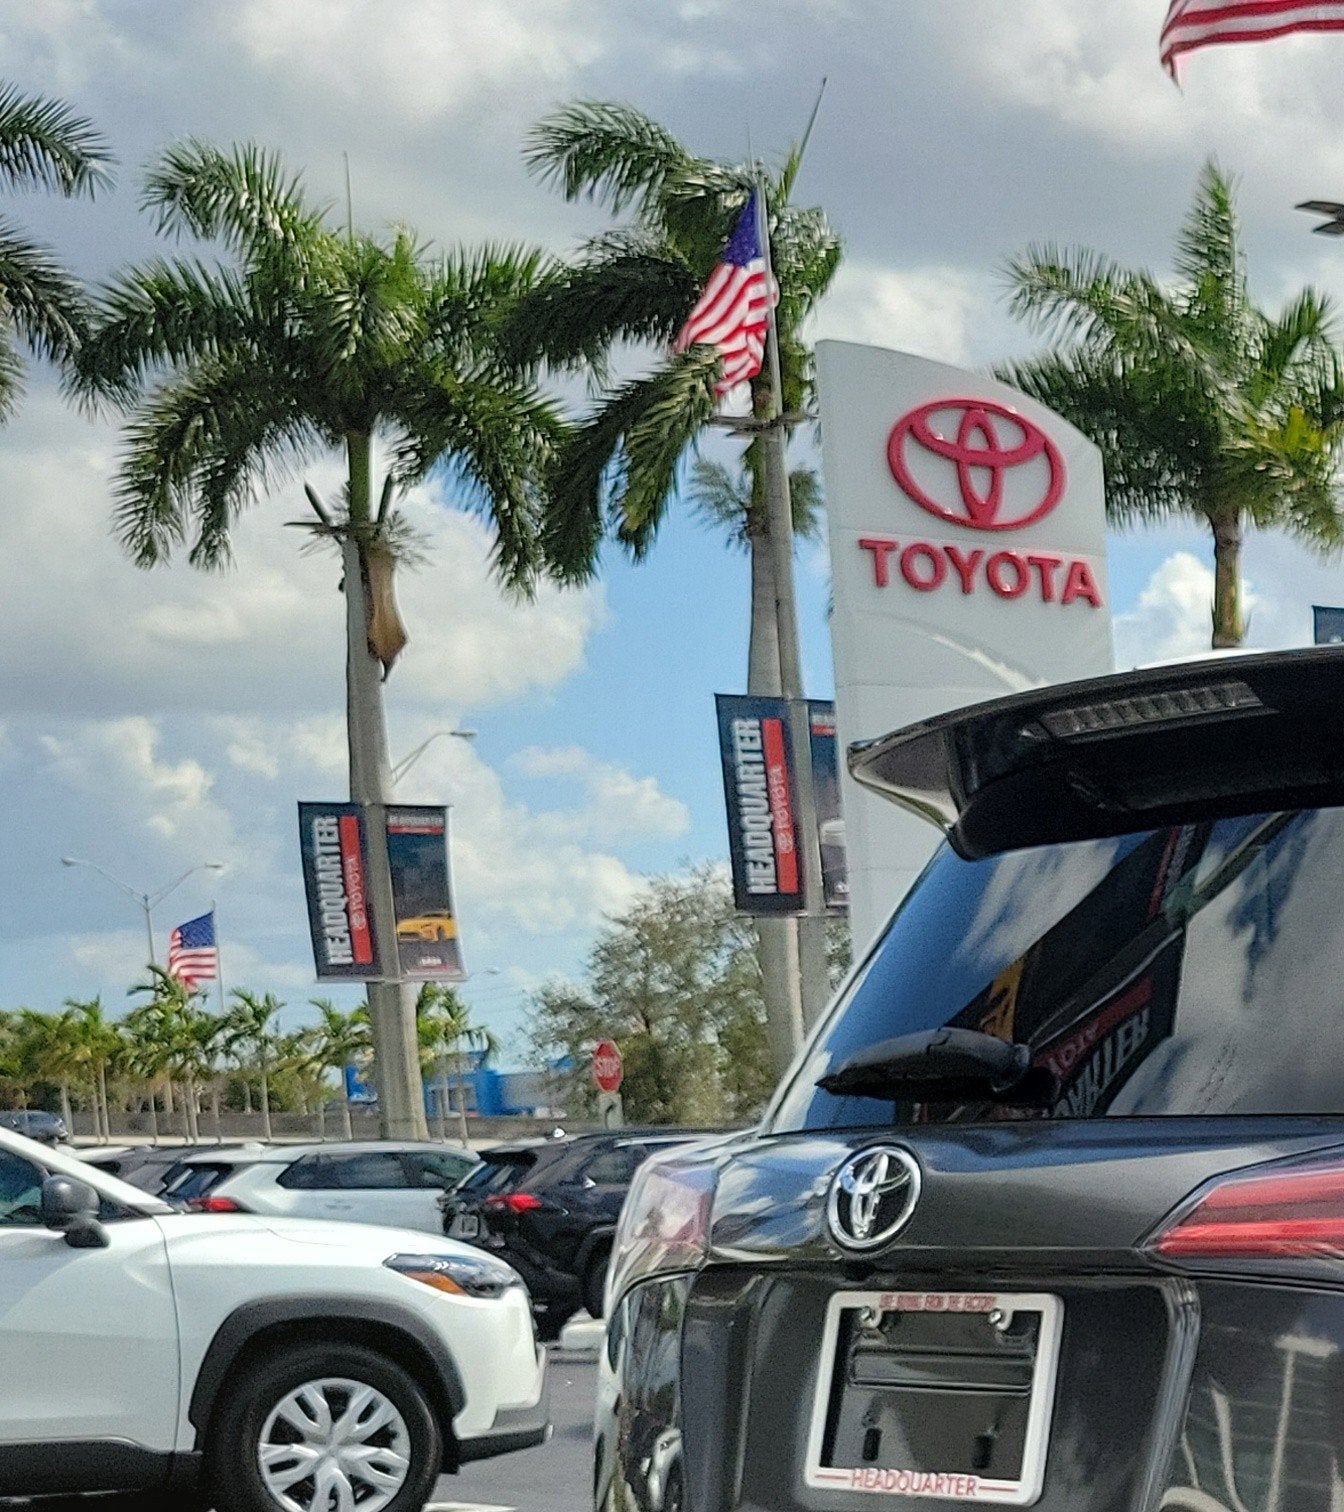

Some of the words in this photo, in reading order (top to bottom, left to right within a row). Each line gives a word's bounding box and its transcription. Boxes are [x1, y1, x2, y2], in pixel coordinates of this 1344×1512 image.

[858, 538, 1102, 608] TOYOTA
[731, 718, 778, 894] HEADQUARTER
[768, 765, 791, 828] TOYOTA
[312, 816, 353, 966] HEADQUARTER
[345, 856, 365, 910] TOYOTA
[595, 1056, 620, 1077] STOP
[851, 1468, 977, 1497] HEADQUARTER
